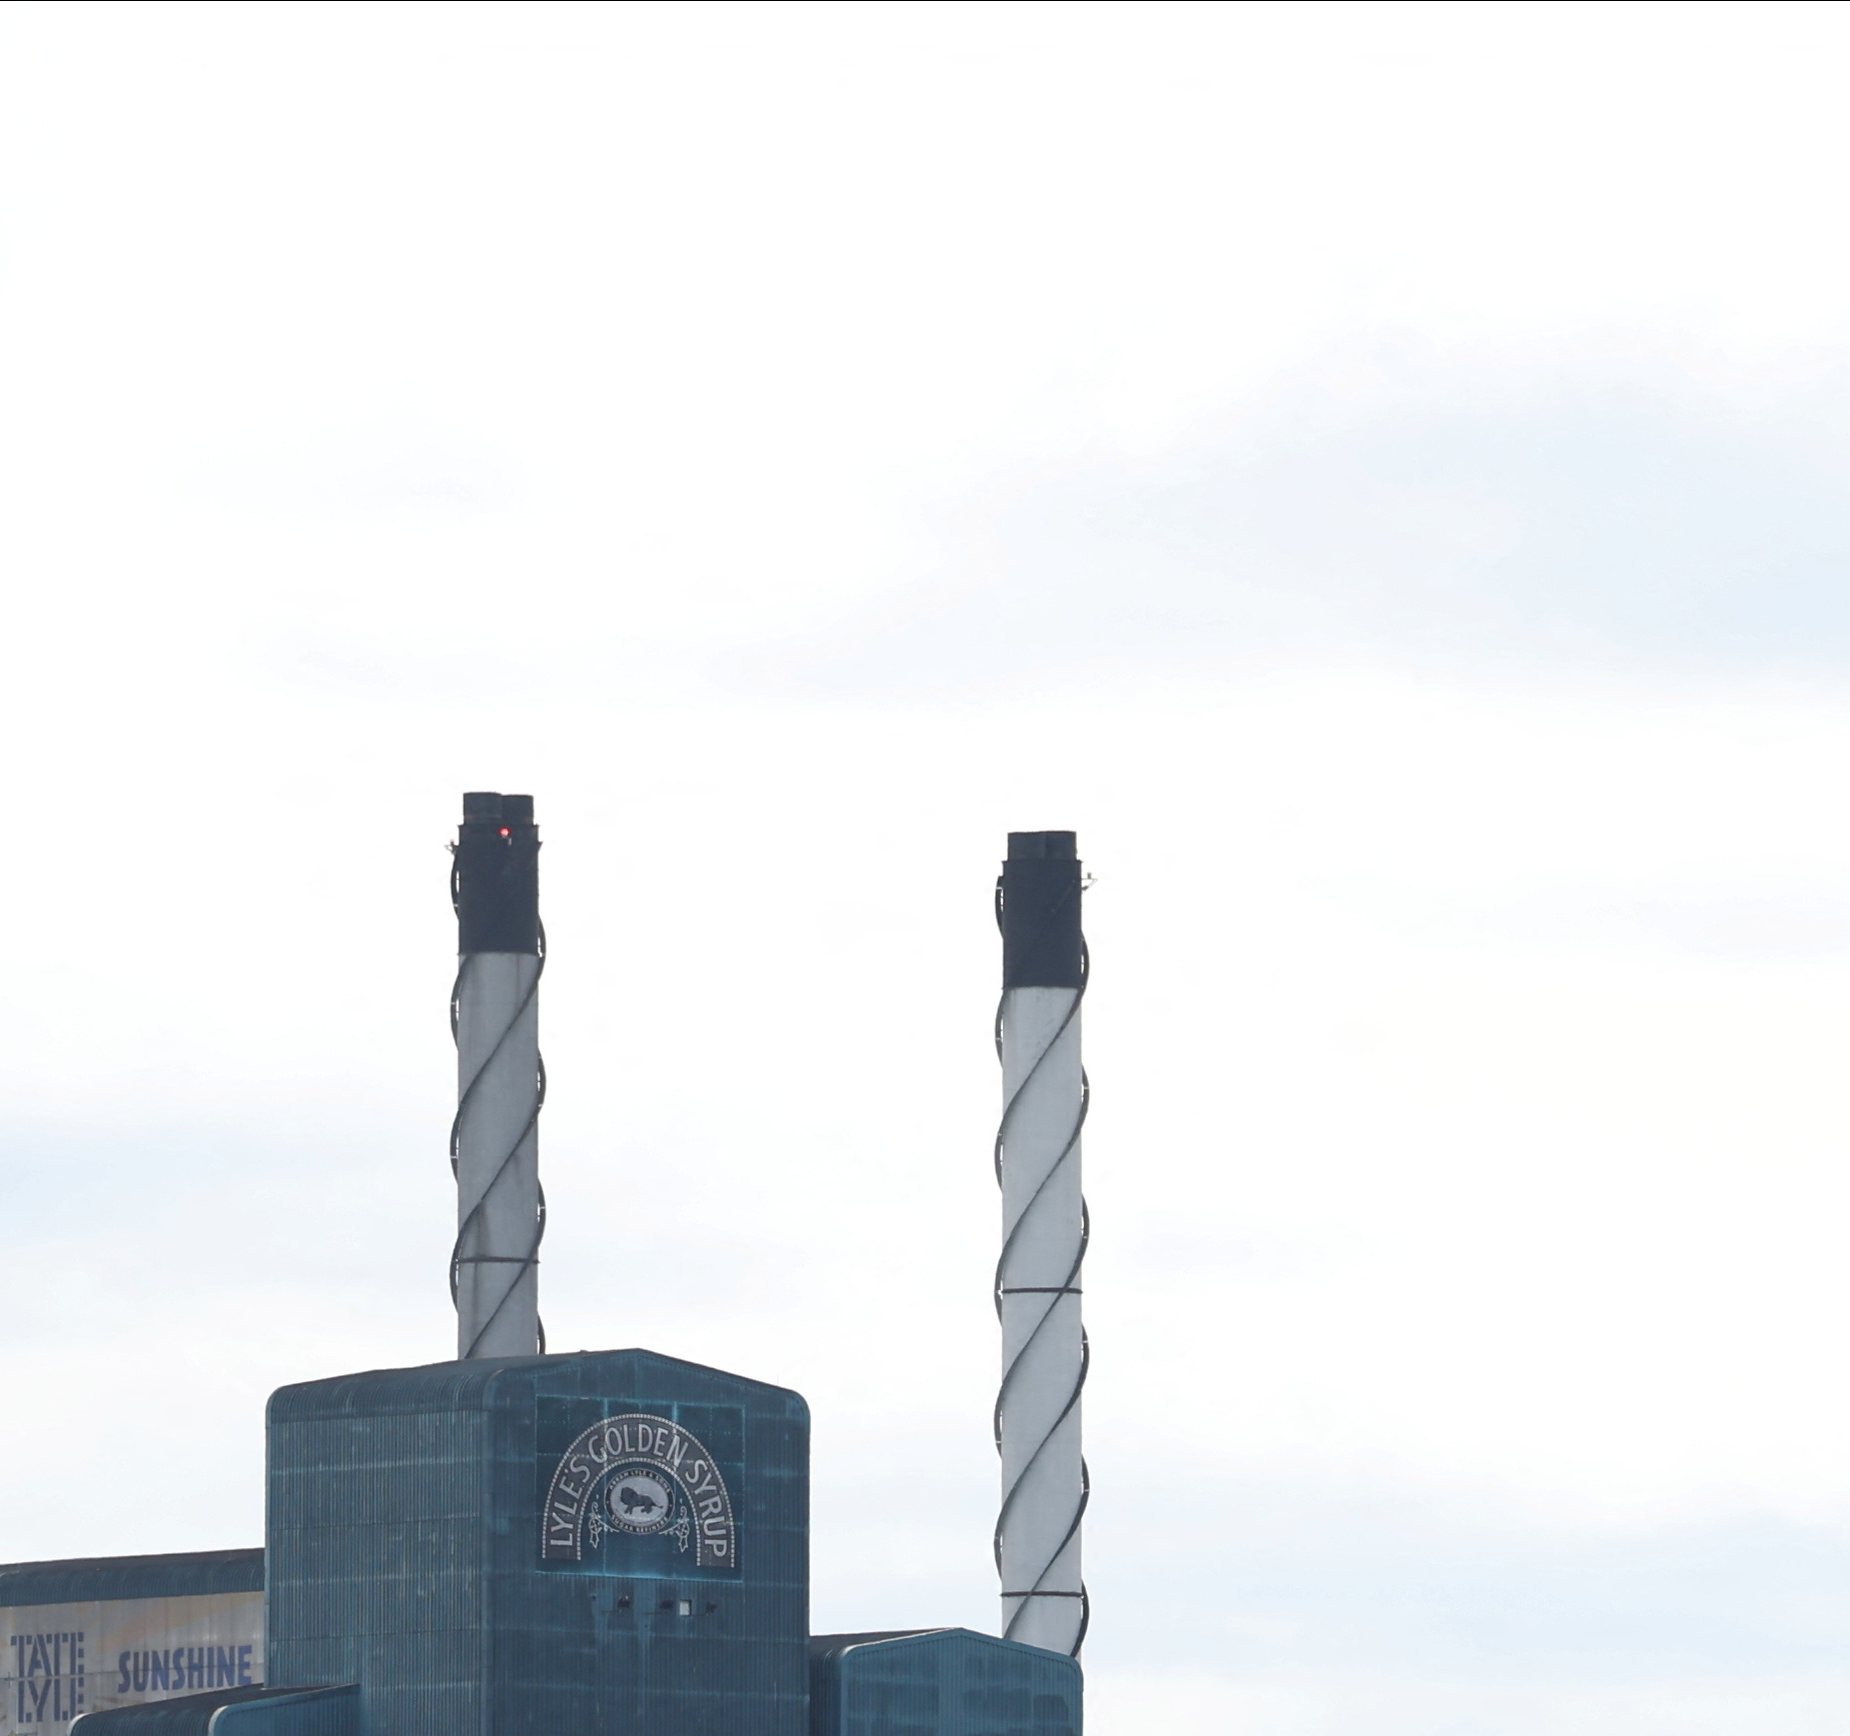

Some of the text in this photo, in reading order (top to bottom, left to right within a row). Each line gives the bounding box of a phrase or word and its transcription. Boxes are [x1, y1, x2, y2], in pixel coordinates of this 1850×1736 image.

[550, 1423, 728, 1558] LYLE'S GOLDEN SYRUP
[10, 1631, 85, 1677] TATE
[117, 1644, 253, 1694] SUNSHINE
[17, 1677, 85, 1724] LYLE
